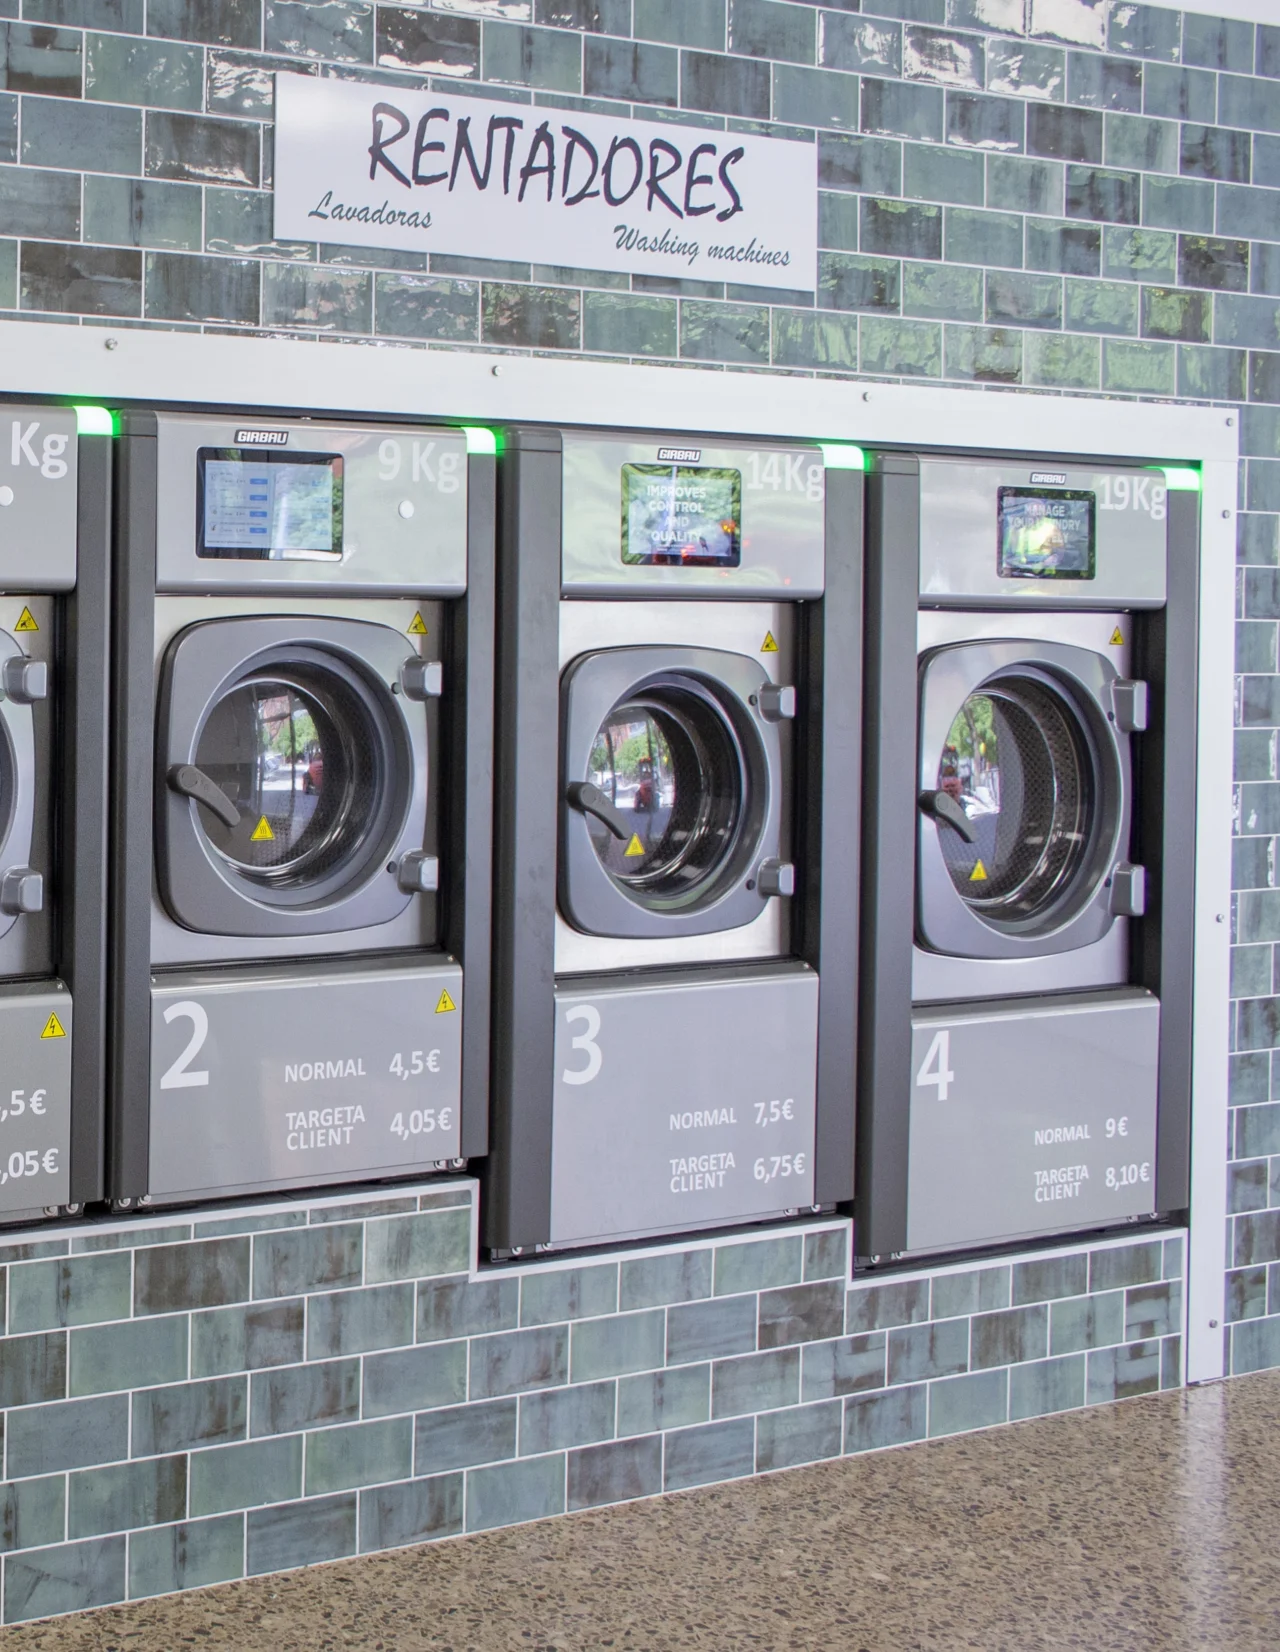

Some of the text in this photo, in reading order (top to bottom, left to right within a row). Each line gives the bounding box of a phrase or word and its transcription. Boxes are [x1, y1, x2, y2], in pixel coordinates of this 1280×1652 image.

[368, 102, 745, 222] RENTADORES
[307, 191, 432, 229] Lavadoras
[613, 225, 791, 266] Washing machines
[11, 421, 69, 479] Kg
[237, 431, 287, 444] GIRBAU
[378, 438, 460, 494] 9 Kg
[659, 449, 700, 461] GIRBAU
[646, 484, 706, 499] IMPROVES
[746, 451, 824, 502] 14Kg
[1031, 473, 1066, 484] GIRBAU
[648, 500, 704, 513] CONTROL
[1099, 475, 1167, 520] 19Kg
[651, 530, 702, 542] QUALITY
[664, 516, 690, 527] AND
[160, 1000, 209, 1090] 2
[562, 1004, 603, 1085] 3
[285, 1049, 441, 1083] NORMAL 4,5€
[916, 1030, 955, 1101] 4
[285, 1105, 452, 1141] TARGETA 4,05€
[669, 1098, 794, 1131] NORMAL 7,5€
[286, 1126, 354, 1151] CLIENT
[1034, 1116, 1129, 1146] NORMAL 9€
[669, 1152, 806, 1184] TARGETA 6,75€
[670, 1171, 726, 1193] CLIENT
[1034, 1162, 1150, 1191] TARGETA 8,10€
[1035, 1181, 1082, 1203] CLIENT
